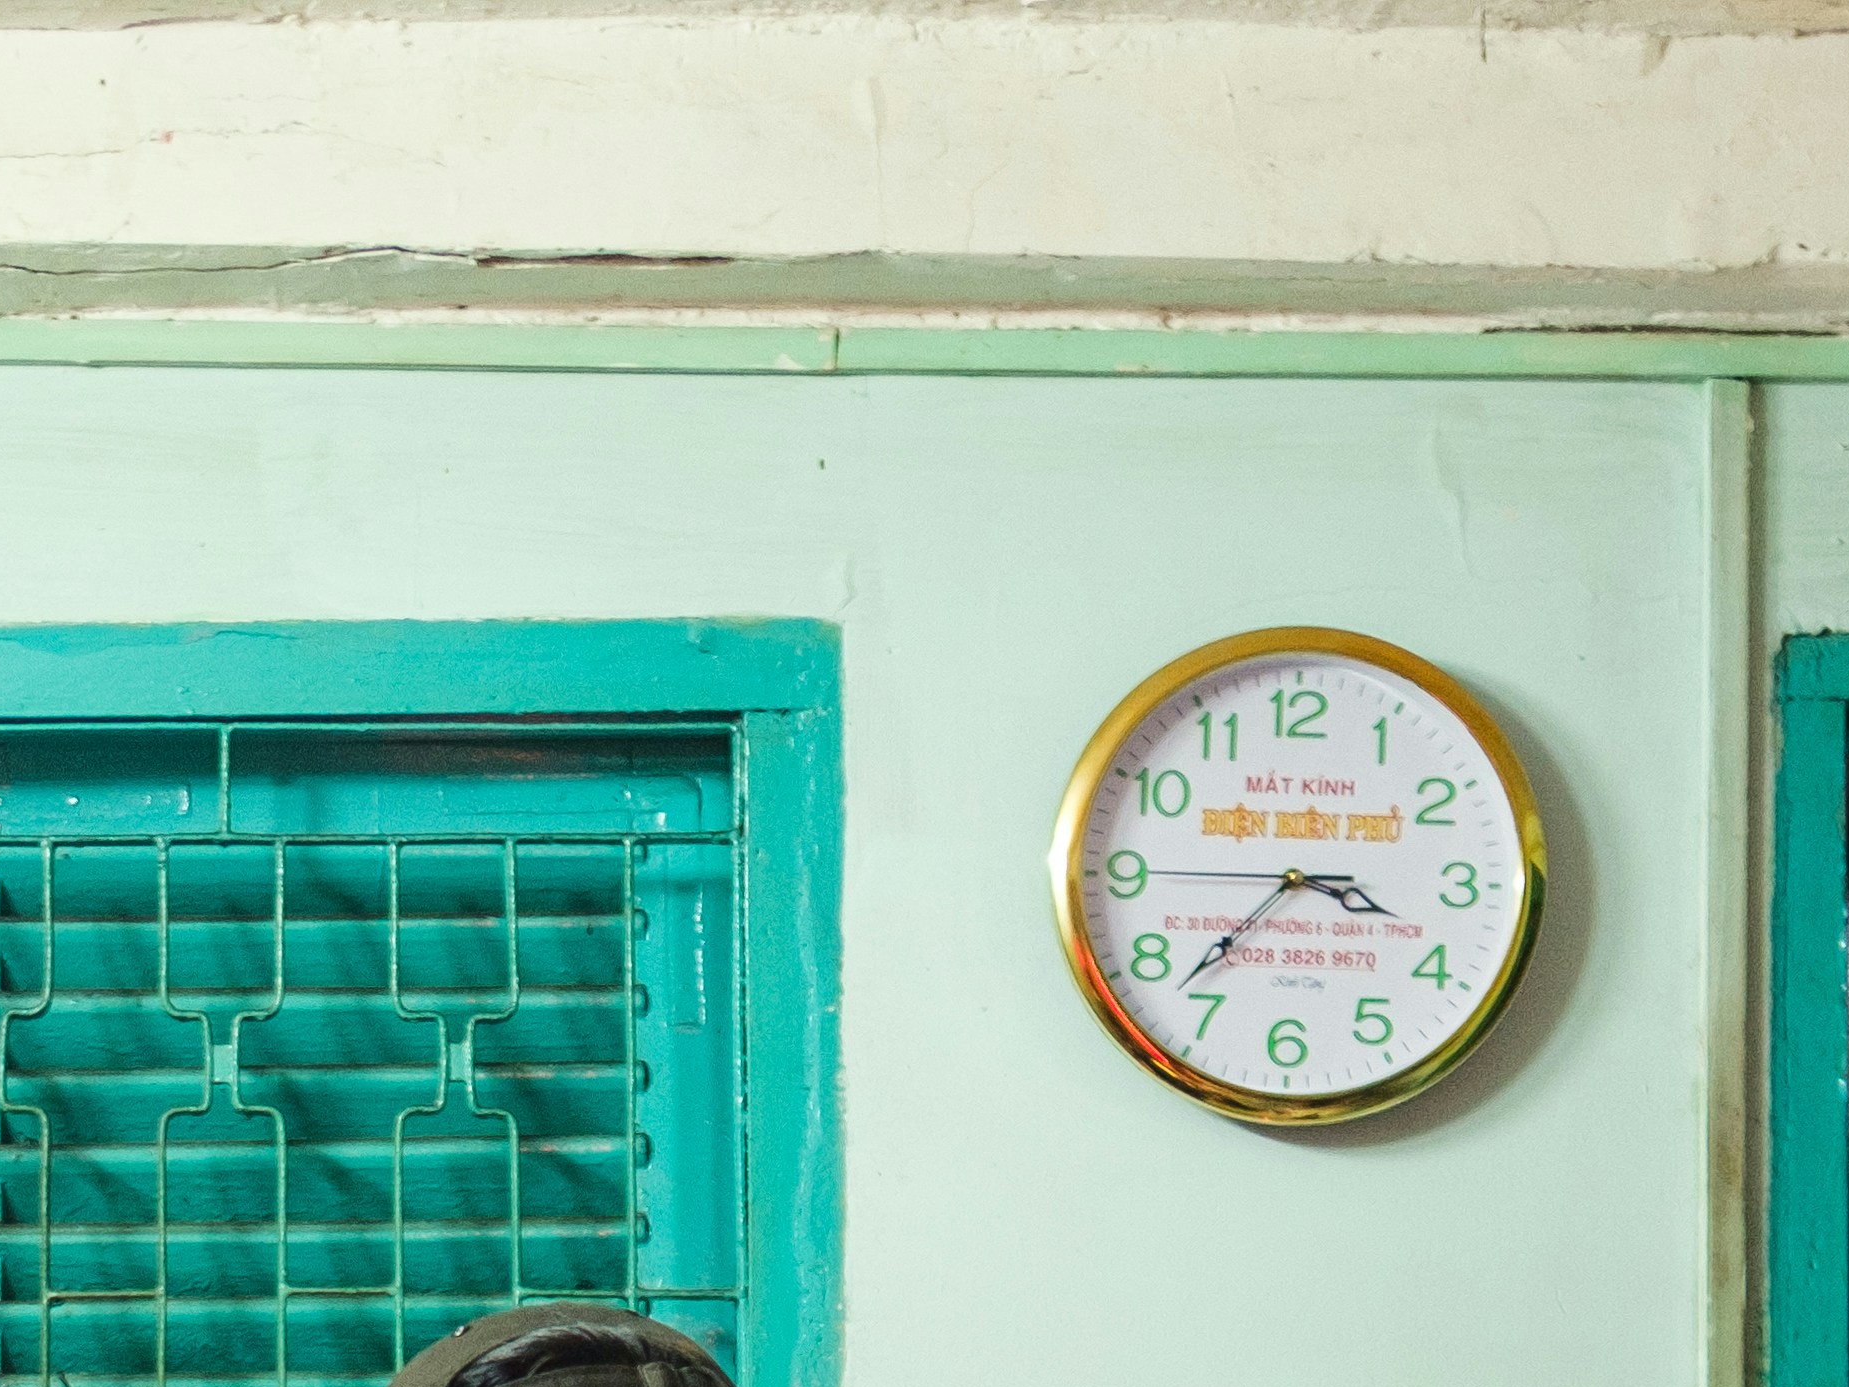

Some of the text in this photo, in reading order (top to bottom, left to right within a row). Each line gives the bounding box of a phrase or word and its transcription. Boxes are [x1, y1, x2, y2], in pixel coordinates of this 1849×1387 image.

[1197, 711, 1239, 762] 11
[1270, 689, 1329, 739] 12
[1372, 715, 1388, 765] 1
[1135, 767, 1192, 818] 10
[1414, 777, 1458, 826] 2
[1345, 803, 1405, 844] PHỦ
[1106, 849, 1149, 900] 9
[1438, 861, 1480, 910] 3
[1130, 933, 1173, 982] 8
[1242, 947, 1275, 964] 028
[1281, 949, 1326, 966] 3826
[1411, 944, 1453, 991] 4
[1187, 993, 1228, 1041] 7
[1353, 998, 1395, 1046] 5
[1267, 1019, 1309, 1068] 6
